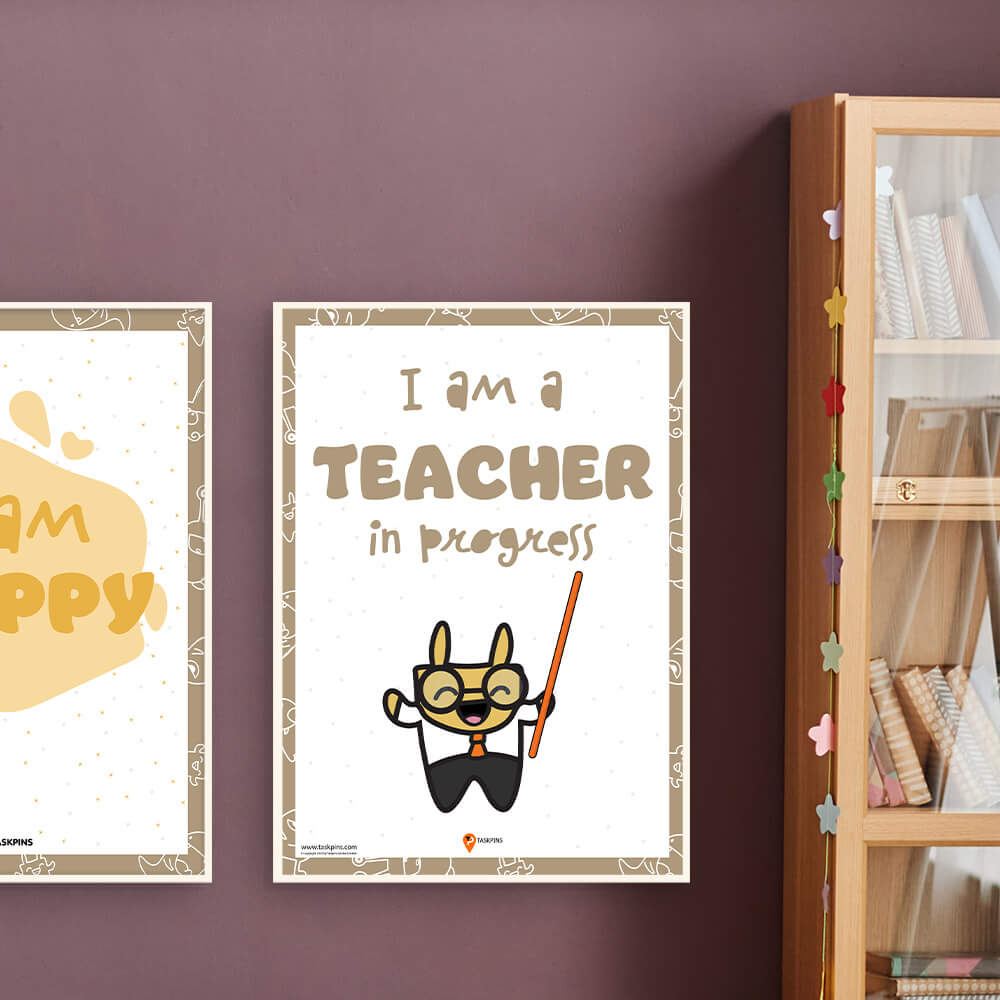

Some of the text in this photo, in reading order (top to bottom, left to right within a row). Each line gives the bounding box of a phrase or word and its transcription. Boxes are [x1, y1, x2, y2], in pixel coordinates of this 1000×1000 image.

[400, 368, 563, 412] I am a
[313, 444, 653, 501] TEACHER
[369, 520, 597, 567] in progress
[300, 844, 358, 852] www.taskpins.com
